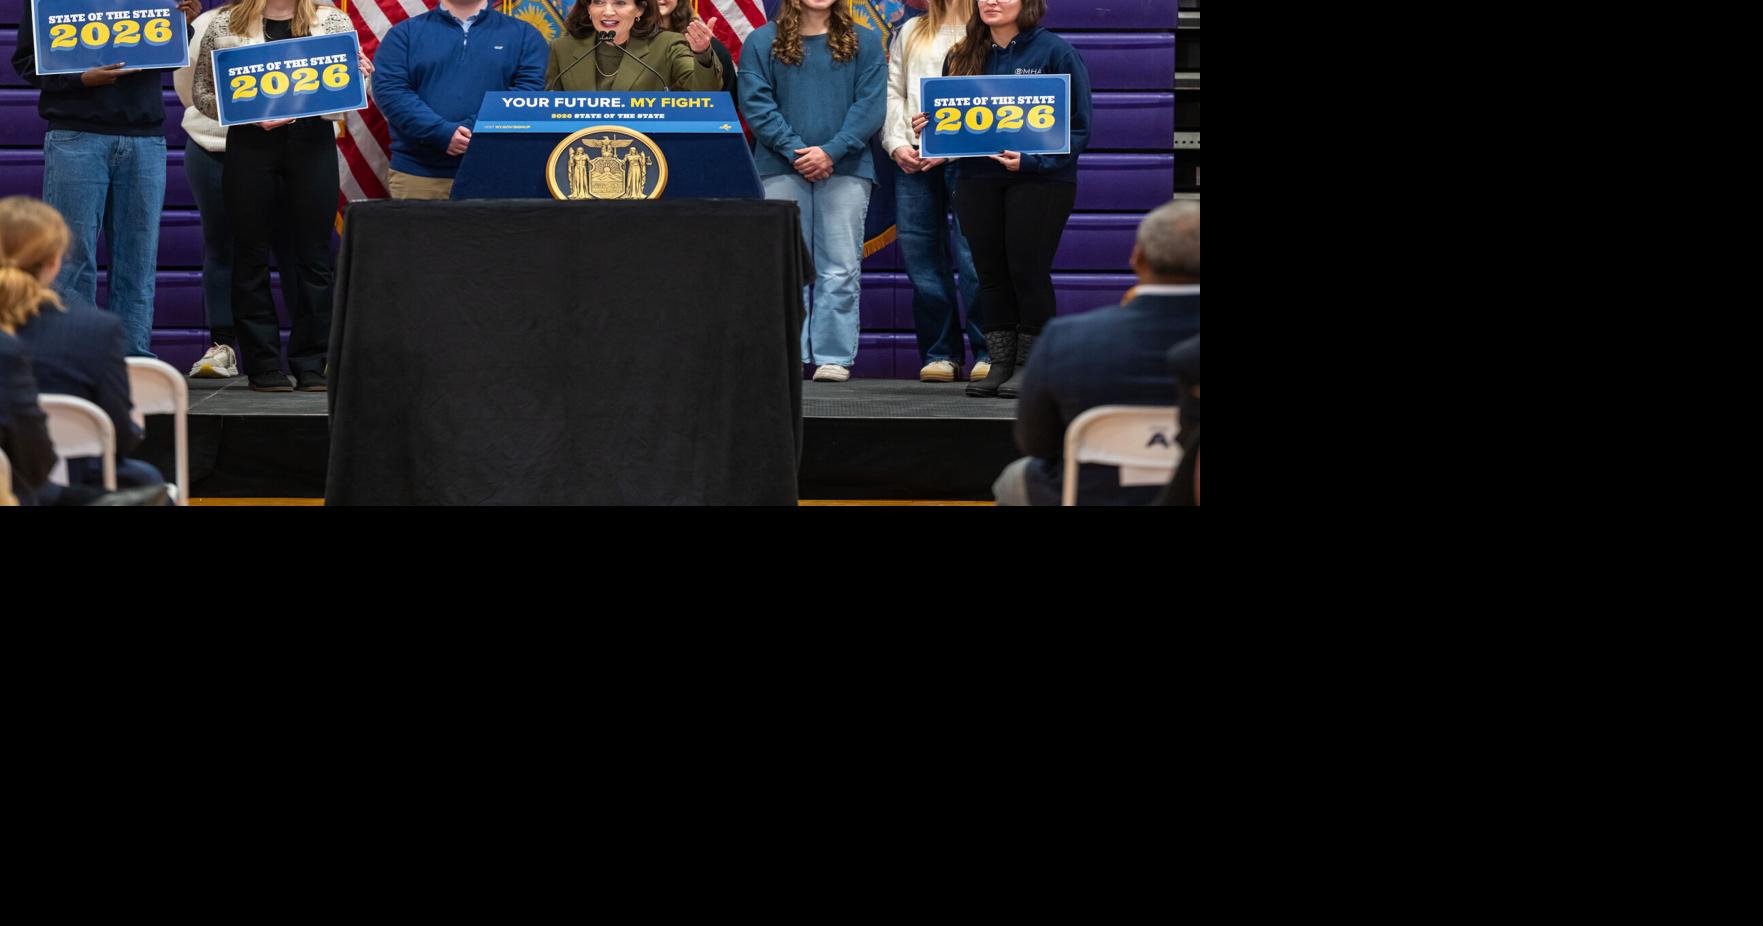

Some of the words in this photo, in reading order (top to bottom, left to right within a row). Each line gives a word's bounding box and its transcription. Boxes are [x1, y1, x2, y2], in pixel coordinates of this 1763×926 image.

[48, 14, 85, 24] STATE
[87, 13, 104, 21] OF
[106, 11, 131, 19] THE
[132, 9, 170, 18] STATE
[49, 18, 173, 51] 2026
[228, 64, 265, 77] STATE
[266, 61, 282, 71] OF
[283, 58, 309, 69] THE
[310, 54, 347, 65] STATE
[230, 63, 350, 103] 2026
[502, 97, 549, 108] YOUR
[554, 97, 625, 108] FUTURE.
[630, 97, 656, 108] MY
[661, 97, 714, 108] FIGHT.
[934, 97, 970, 107] STATE
[973, 97, 989, 105] OF
[990, 96, 1015, 105] THE
[1017, 95, 1055, 104] STATE
[934, 105, 1056, 135] 2026
